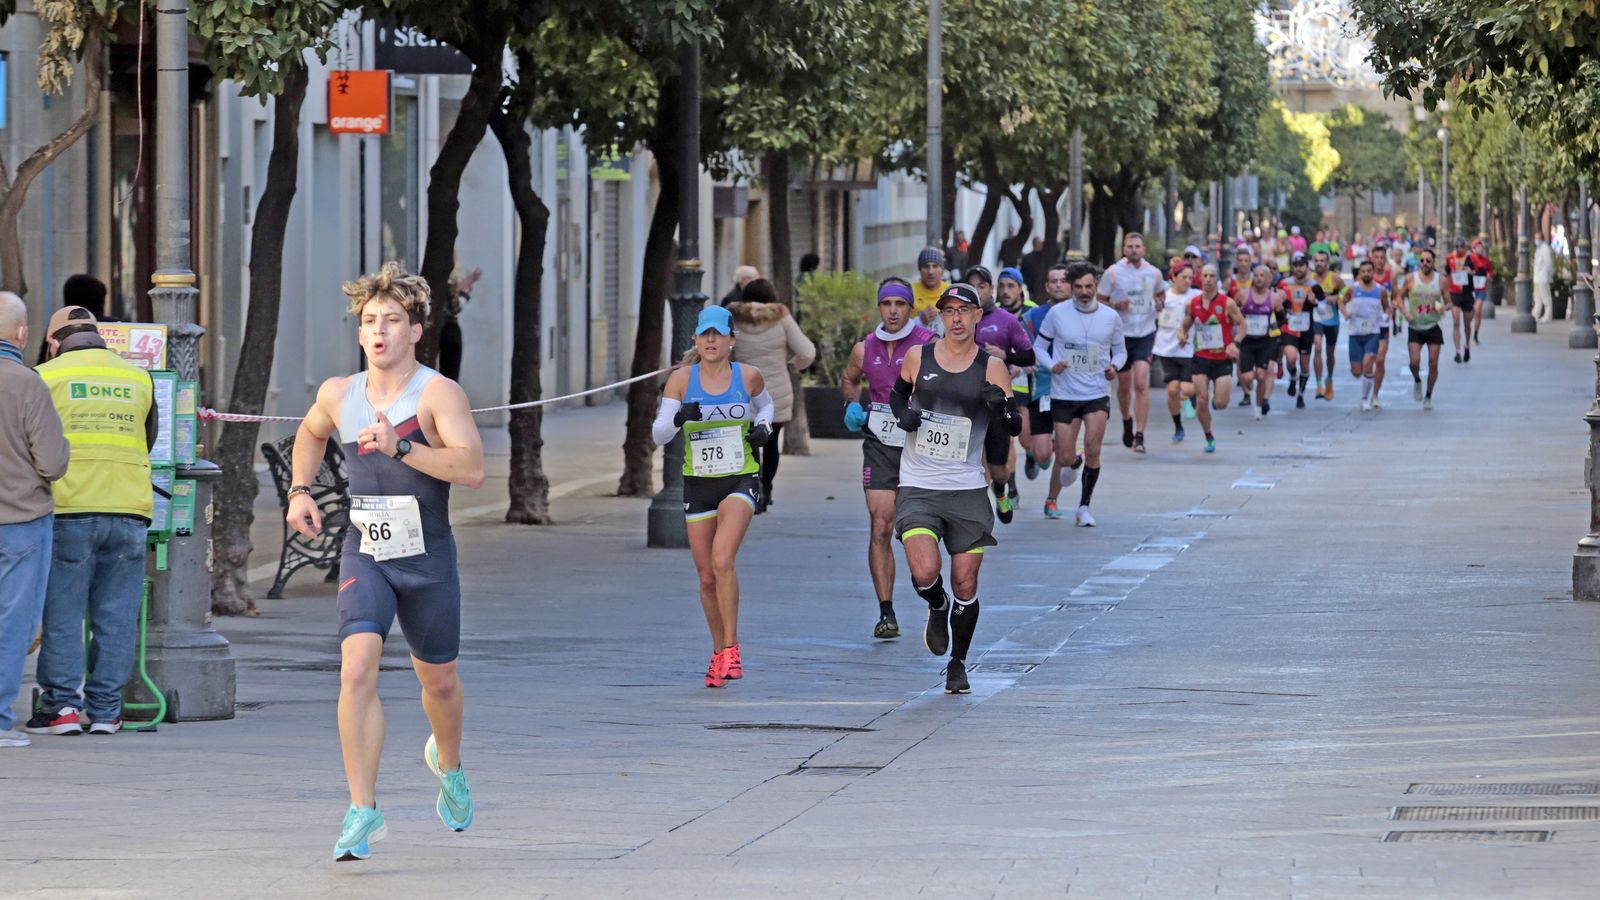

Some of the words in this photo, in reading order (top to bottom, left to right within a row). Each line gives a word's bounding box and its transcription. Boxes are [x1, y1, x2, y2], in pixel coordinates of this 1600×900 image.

[331, 116, 382, 132] orange
[1071, 355, 1088, 364] 176
[90, 386, 131, 399] ONCE
[109, 412, 135, 423] ONCE
[699, 404, 746, 421] AO
[926, 429, 950, 446] 303
[701, 446, 724, 462] 578
